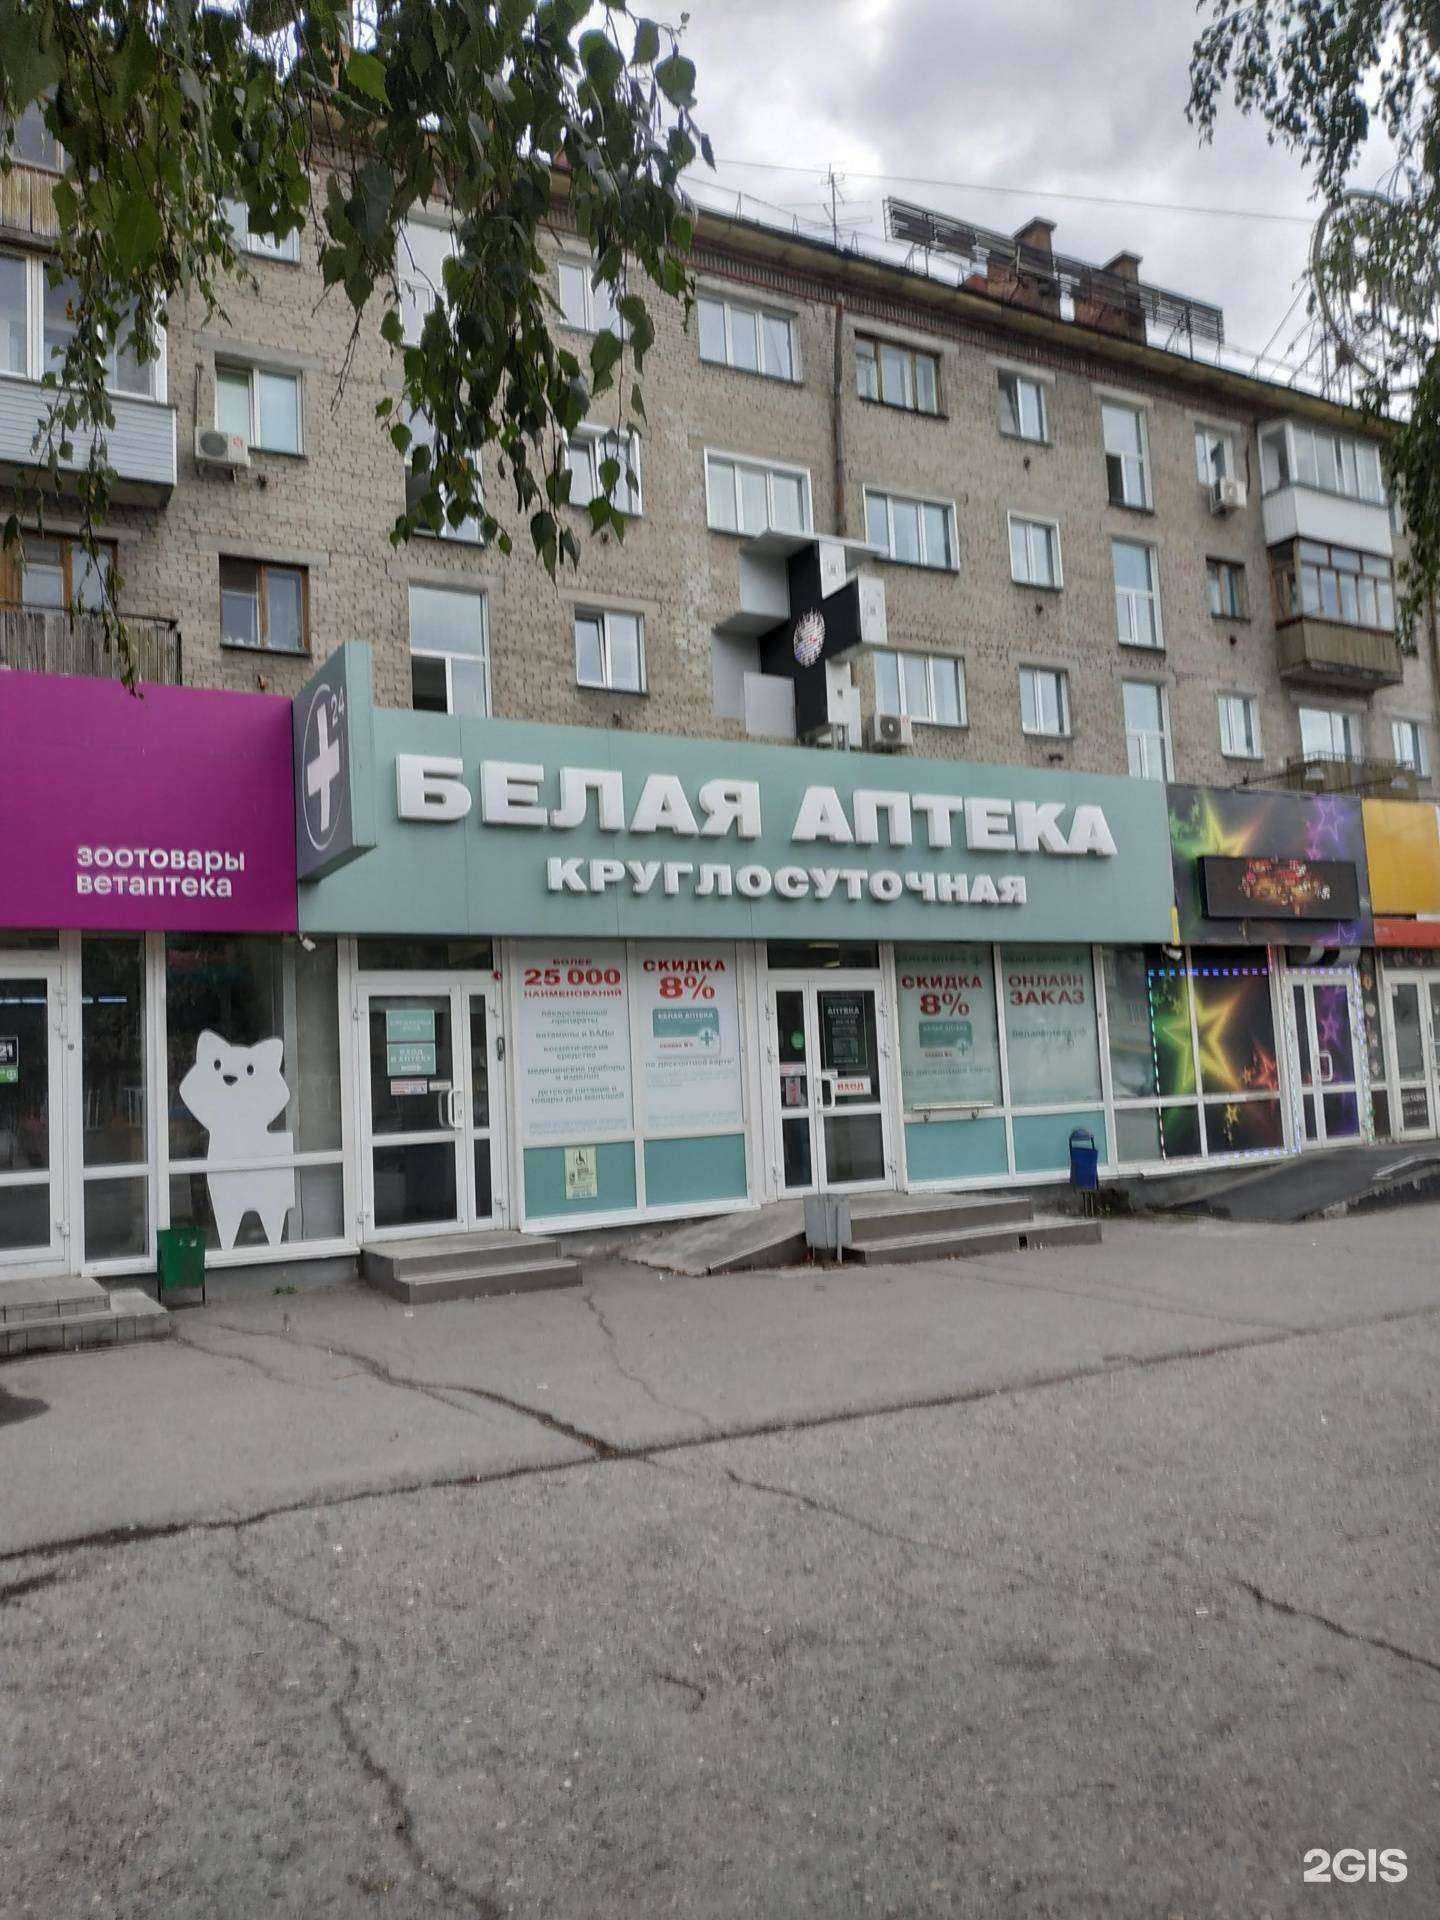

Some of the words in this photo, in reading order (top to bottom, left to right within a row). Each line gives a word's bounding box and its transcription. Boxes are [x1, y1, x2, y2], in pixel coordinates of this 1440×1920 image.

[330, 686, 346, 726] 24
[395, 753, 763, 840] БЕЛАЯ
[791, 785, 1119, 857] АПТЕКА
[76, 845, 246, 875] зоотовары
[76, 872, 233, 898] ветаптека
[546, 855, 1029, 905] КРУГЛОСУТОЧНАЯ
[524, 968, 561, 987] 25
[566, 967, 622, 987] 000
[642, 958, 727, 974] СКИДКА
[659, 975, 716, 1001] 8%
[901, 973, 984, 990] СКИДКА
[919, 992, 971, 1018] 8%
[1009, 989, 1086, 1006] ЗАКАЗ
